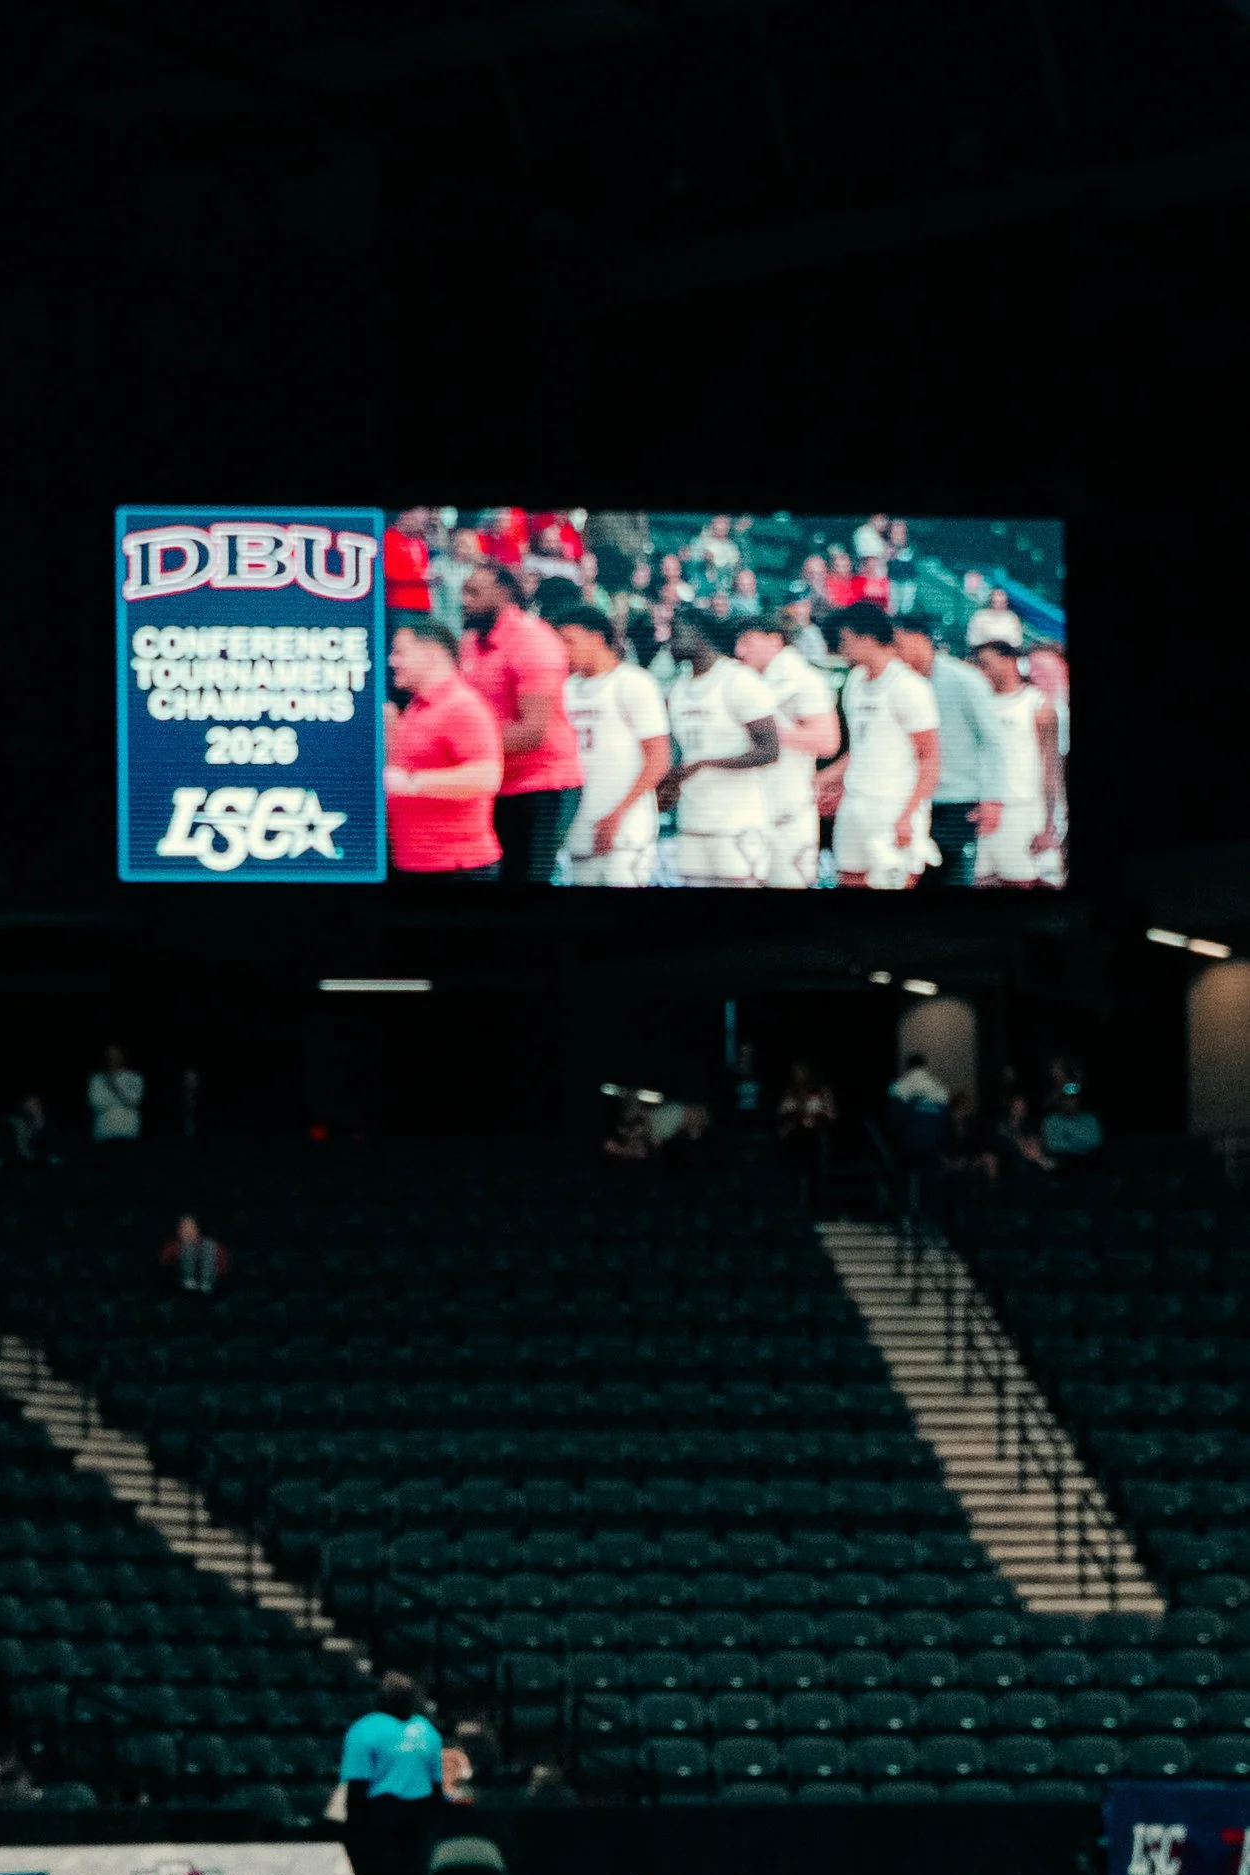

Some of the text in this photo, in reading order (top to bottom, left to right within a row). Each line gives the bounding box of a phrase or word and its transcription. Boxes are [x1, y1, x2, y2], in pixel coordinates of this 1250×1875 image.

[122, 522, 378, 601] DBU
[132, 625, 369, 661] CONFERENCE
[130, 657, 372, 692] TOURNAMENT
[147, 688, 355, 722] CHAMPIONS
[205, 726, 299, 765] 2026
[156, 786, 303, 872] LSC
